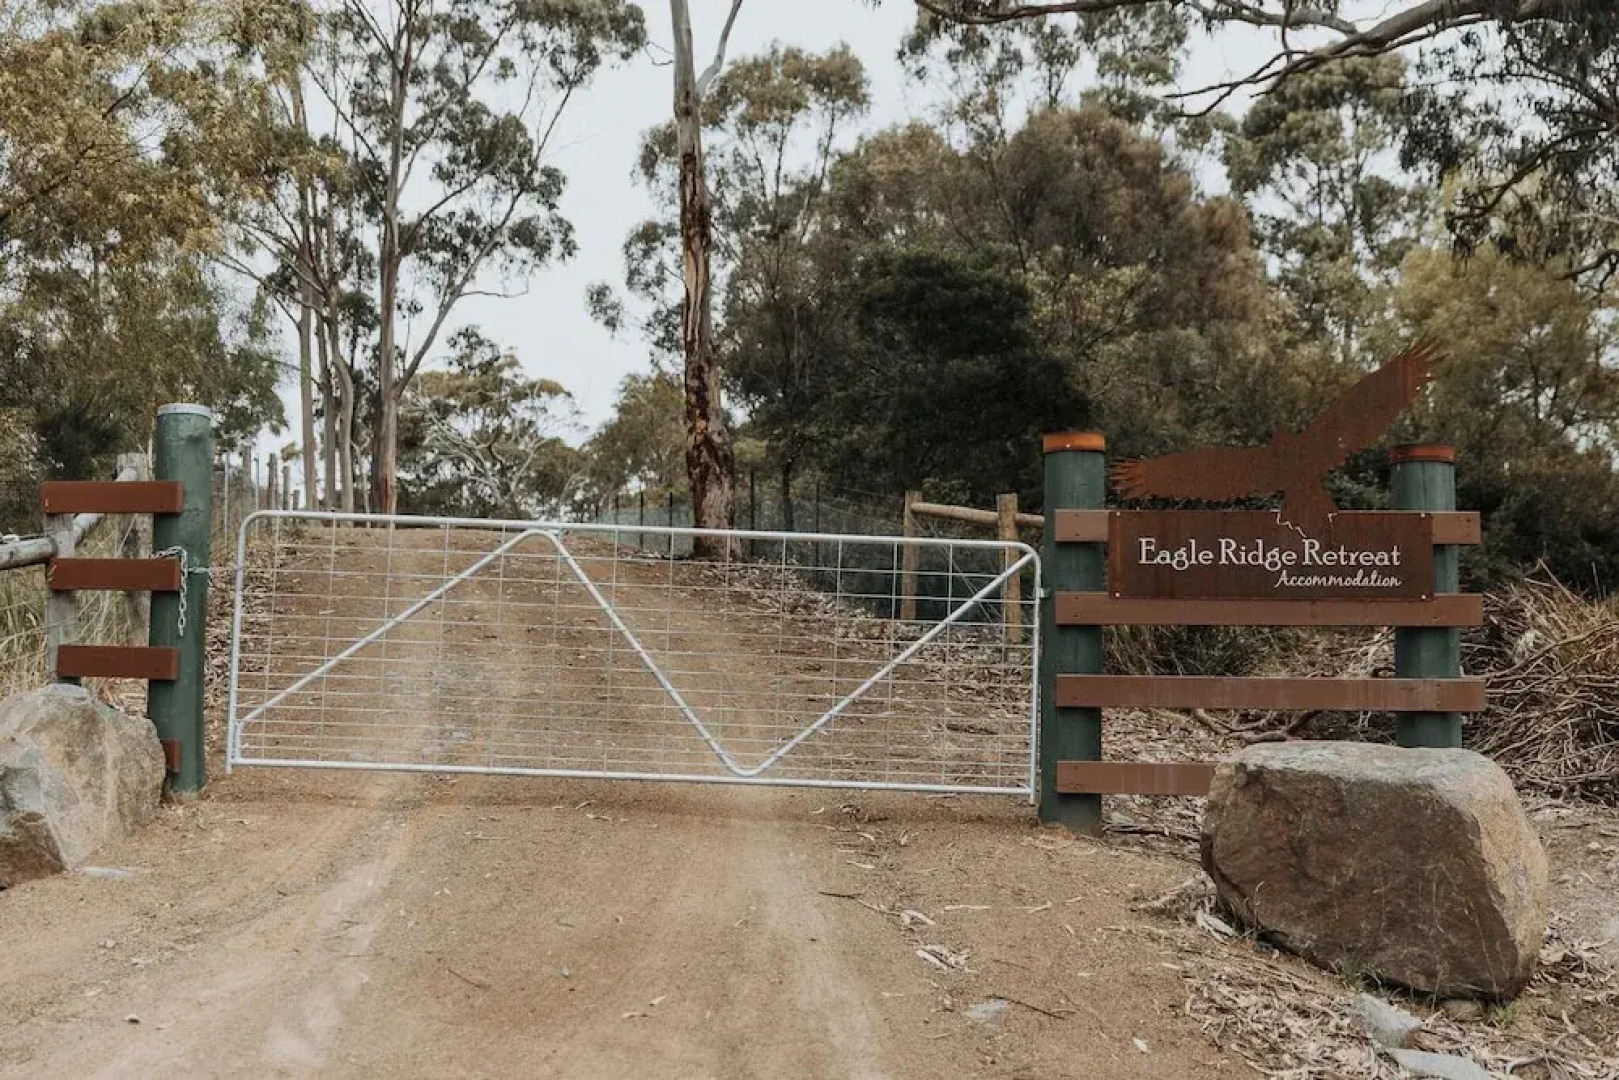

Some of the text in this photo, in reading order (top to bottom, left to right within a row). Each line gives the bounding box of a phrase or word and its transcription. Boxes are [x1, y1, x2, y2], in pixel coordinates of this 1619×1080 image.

[1138, 538, 1401, 571] Eagle Ridge Retreat
[1275, 569, 1401, 588] Accommodation
